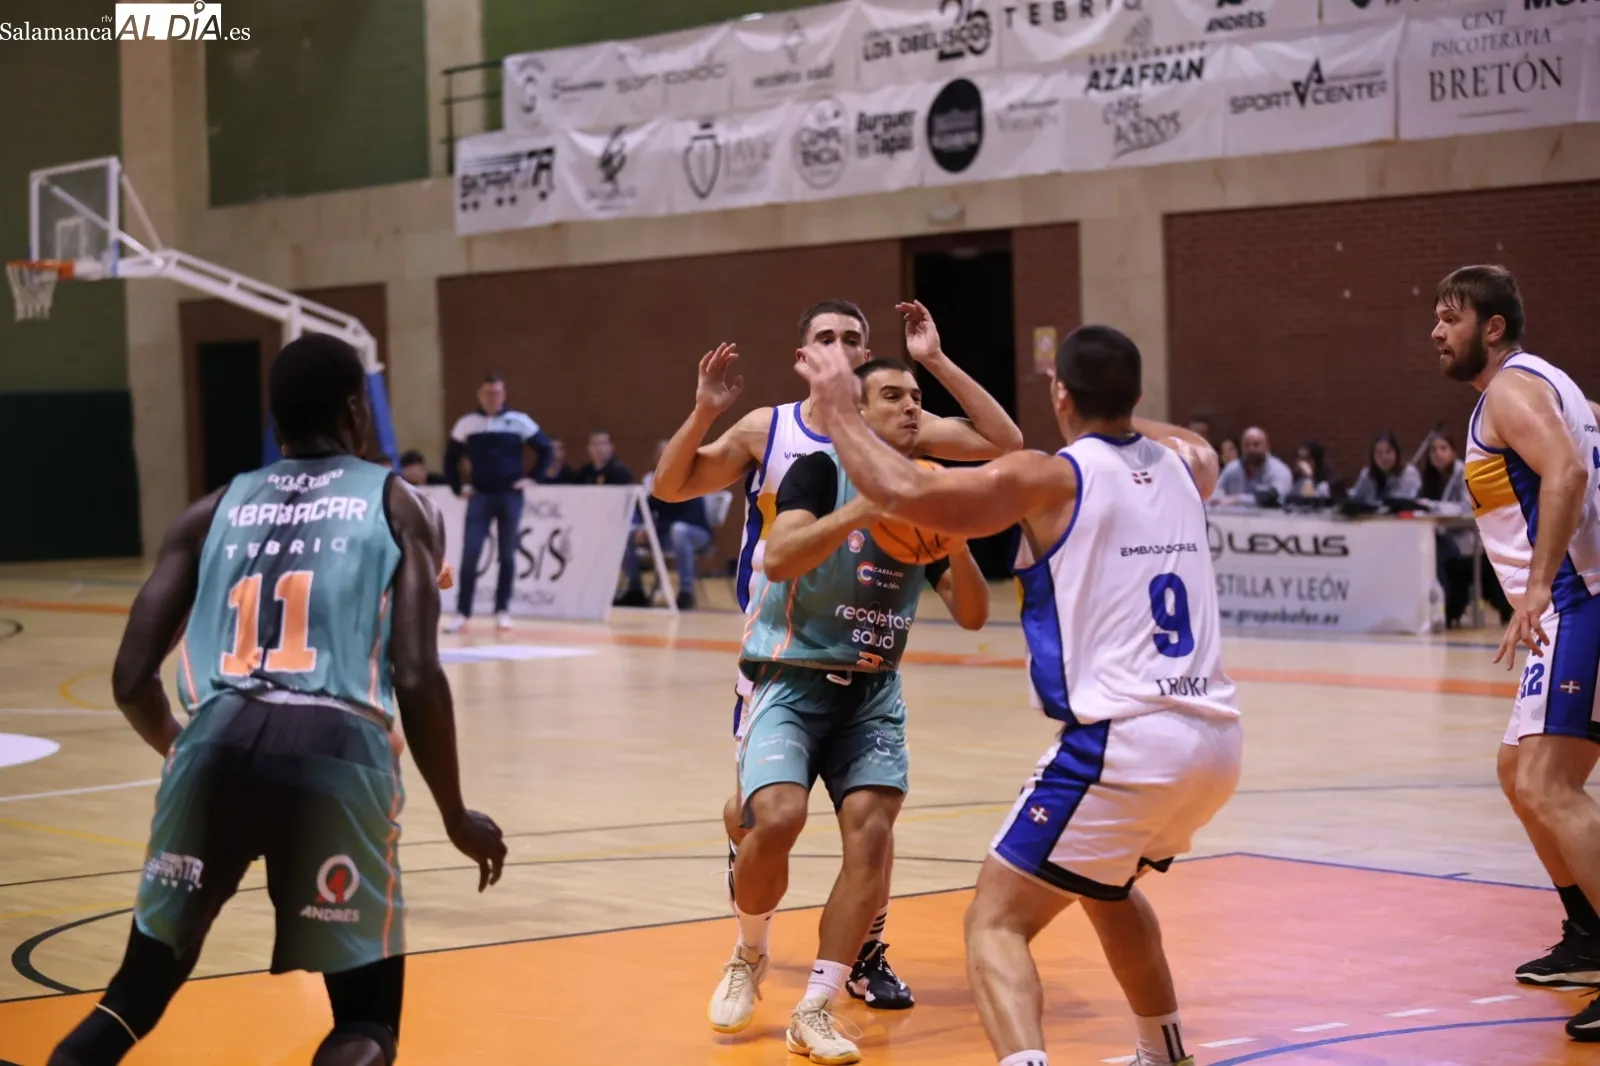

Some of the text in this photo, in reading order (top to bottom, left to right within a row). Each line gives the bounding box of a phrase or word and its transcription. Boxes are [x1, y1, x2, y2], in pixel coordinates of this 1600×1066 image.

[862, 40, 892, 61] LOS
[1430, 27, 1552, 56] PSICOTERAPIA
[1429, 52, 1564, 103] BRETÓN
[1229, 91, 1293, 115] SPORT
[1120, 543, 1197, 557] EMBAJADORES
[1227, 532, 1349, 557] LEXUS
[1215, 572, 1350, 600] STILLA Y LEÓN
[220, 570, 317, 676] 11
[835, 604, 912, 628] recoletas
[1149, 572, 1194, 658] 9
[851, 627, 894, 649] salud
